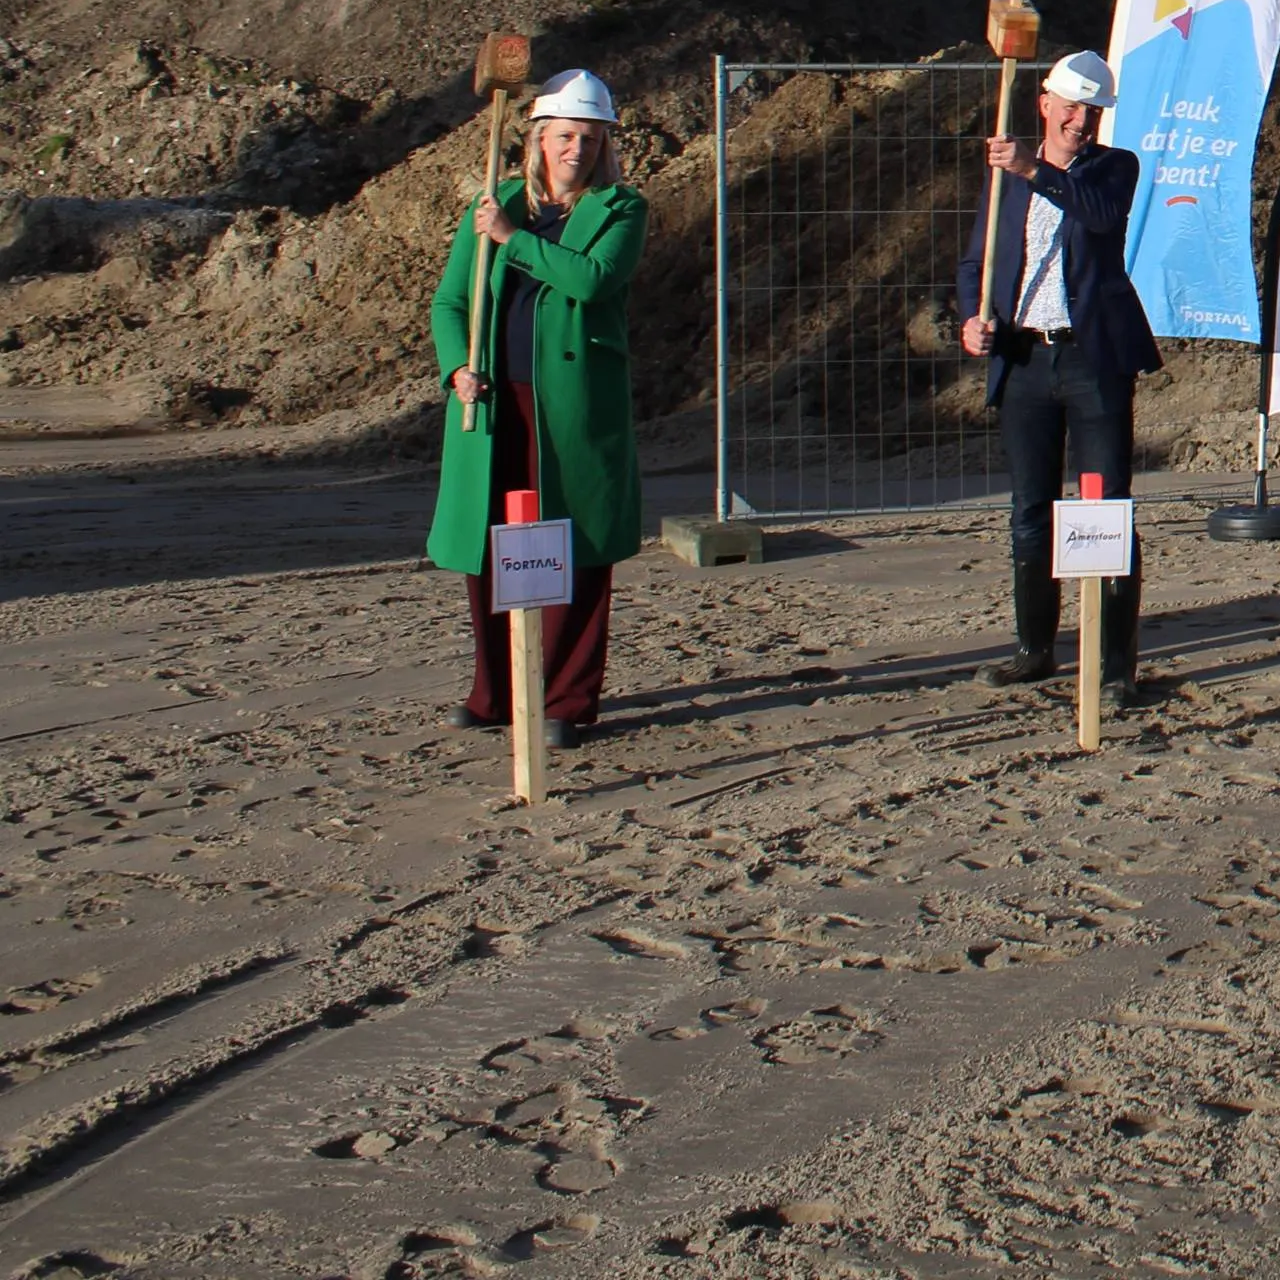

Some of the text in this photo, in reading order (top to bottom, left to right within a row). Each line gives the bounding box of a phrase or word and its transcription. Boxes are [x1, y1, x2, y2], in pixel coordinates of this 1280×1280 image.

[1160, 92, 1220, 123] Leuk
[1141, 124, 1238, 159] dat je er
[1154, 158, 1220, 188] bent!
[1183, 310, 1249, 327] PORTAAL
[1065, 530, 1122, 545] Amersfoort
[504, 558, 559, 572] PORTAAL
